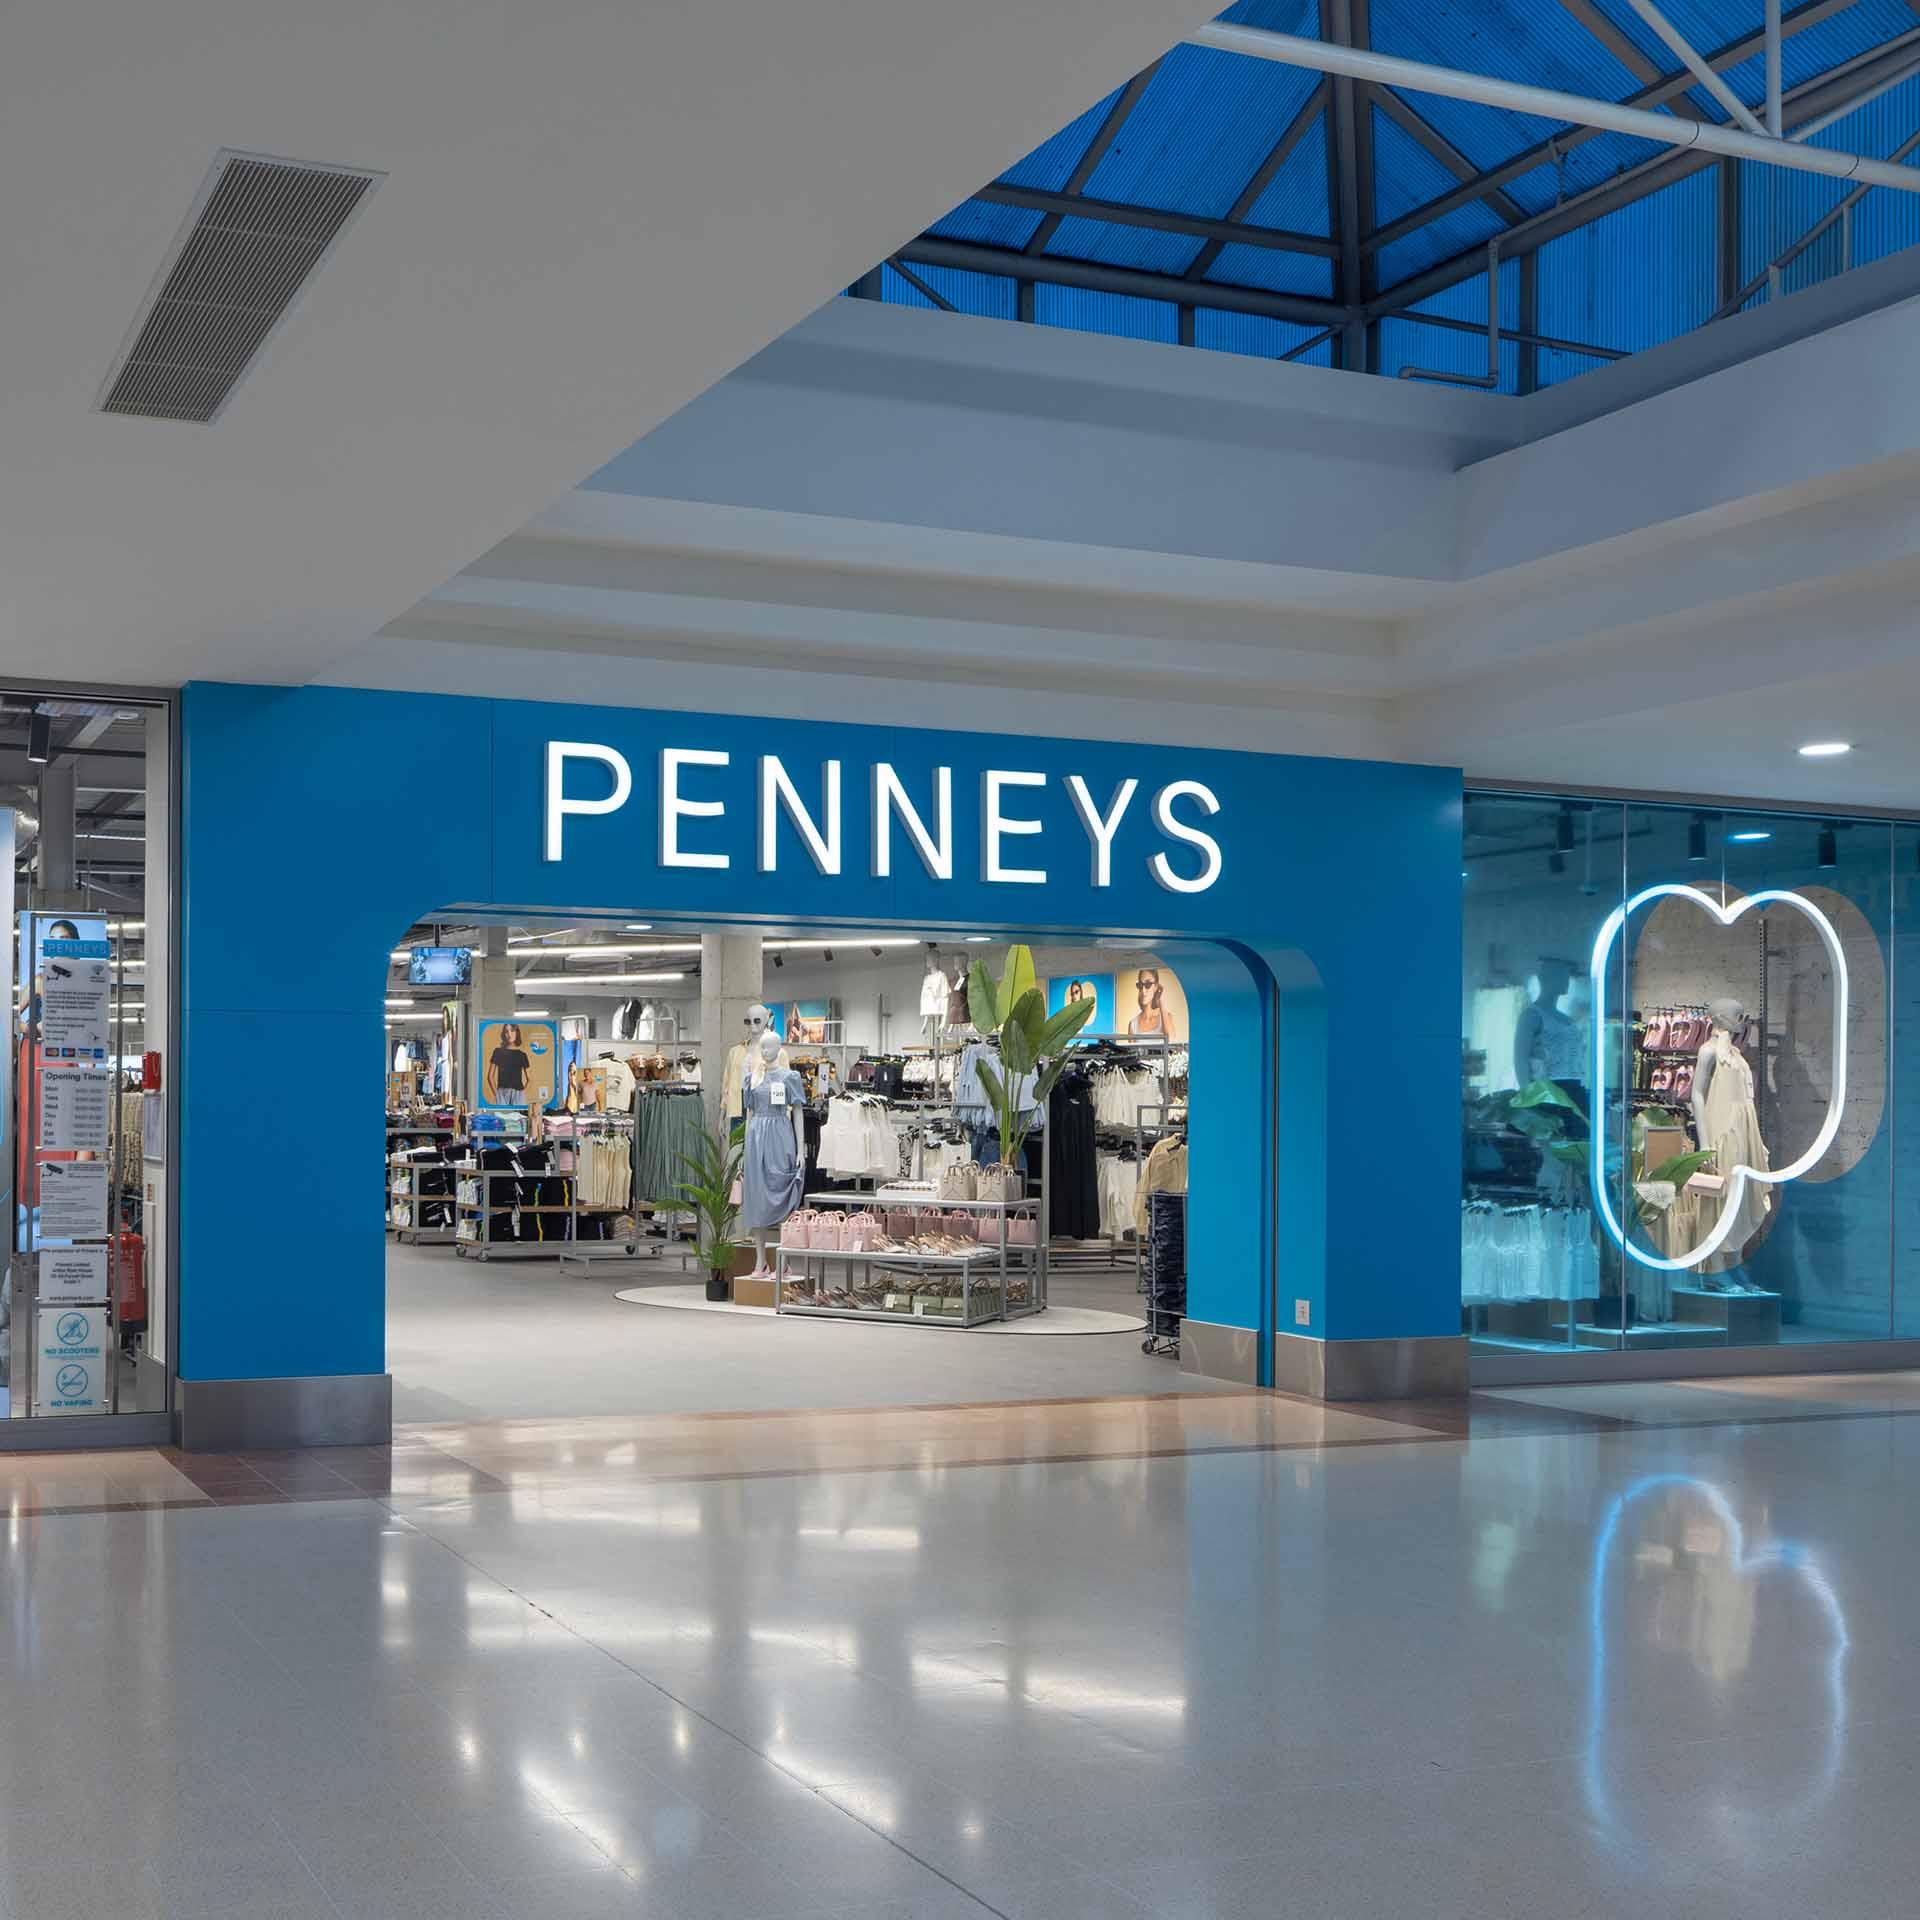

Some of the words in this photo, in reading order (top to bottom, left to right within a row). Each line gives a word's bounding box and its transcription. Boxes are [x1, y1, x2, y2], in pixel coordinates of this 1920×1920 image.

[543, 740, 1223, 895] PENNEYS
[47, 942, 107, 955] PENNEYS
[45, 1071, 81, 1082] Opening
[83, 1072, 107, 1081] Times
[57, 1346, 100, 1355] SCOOTERS
[63, 1399, 93, 1407] VAPING
